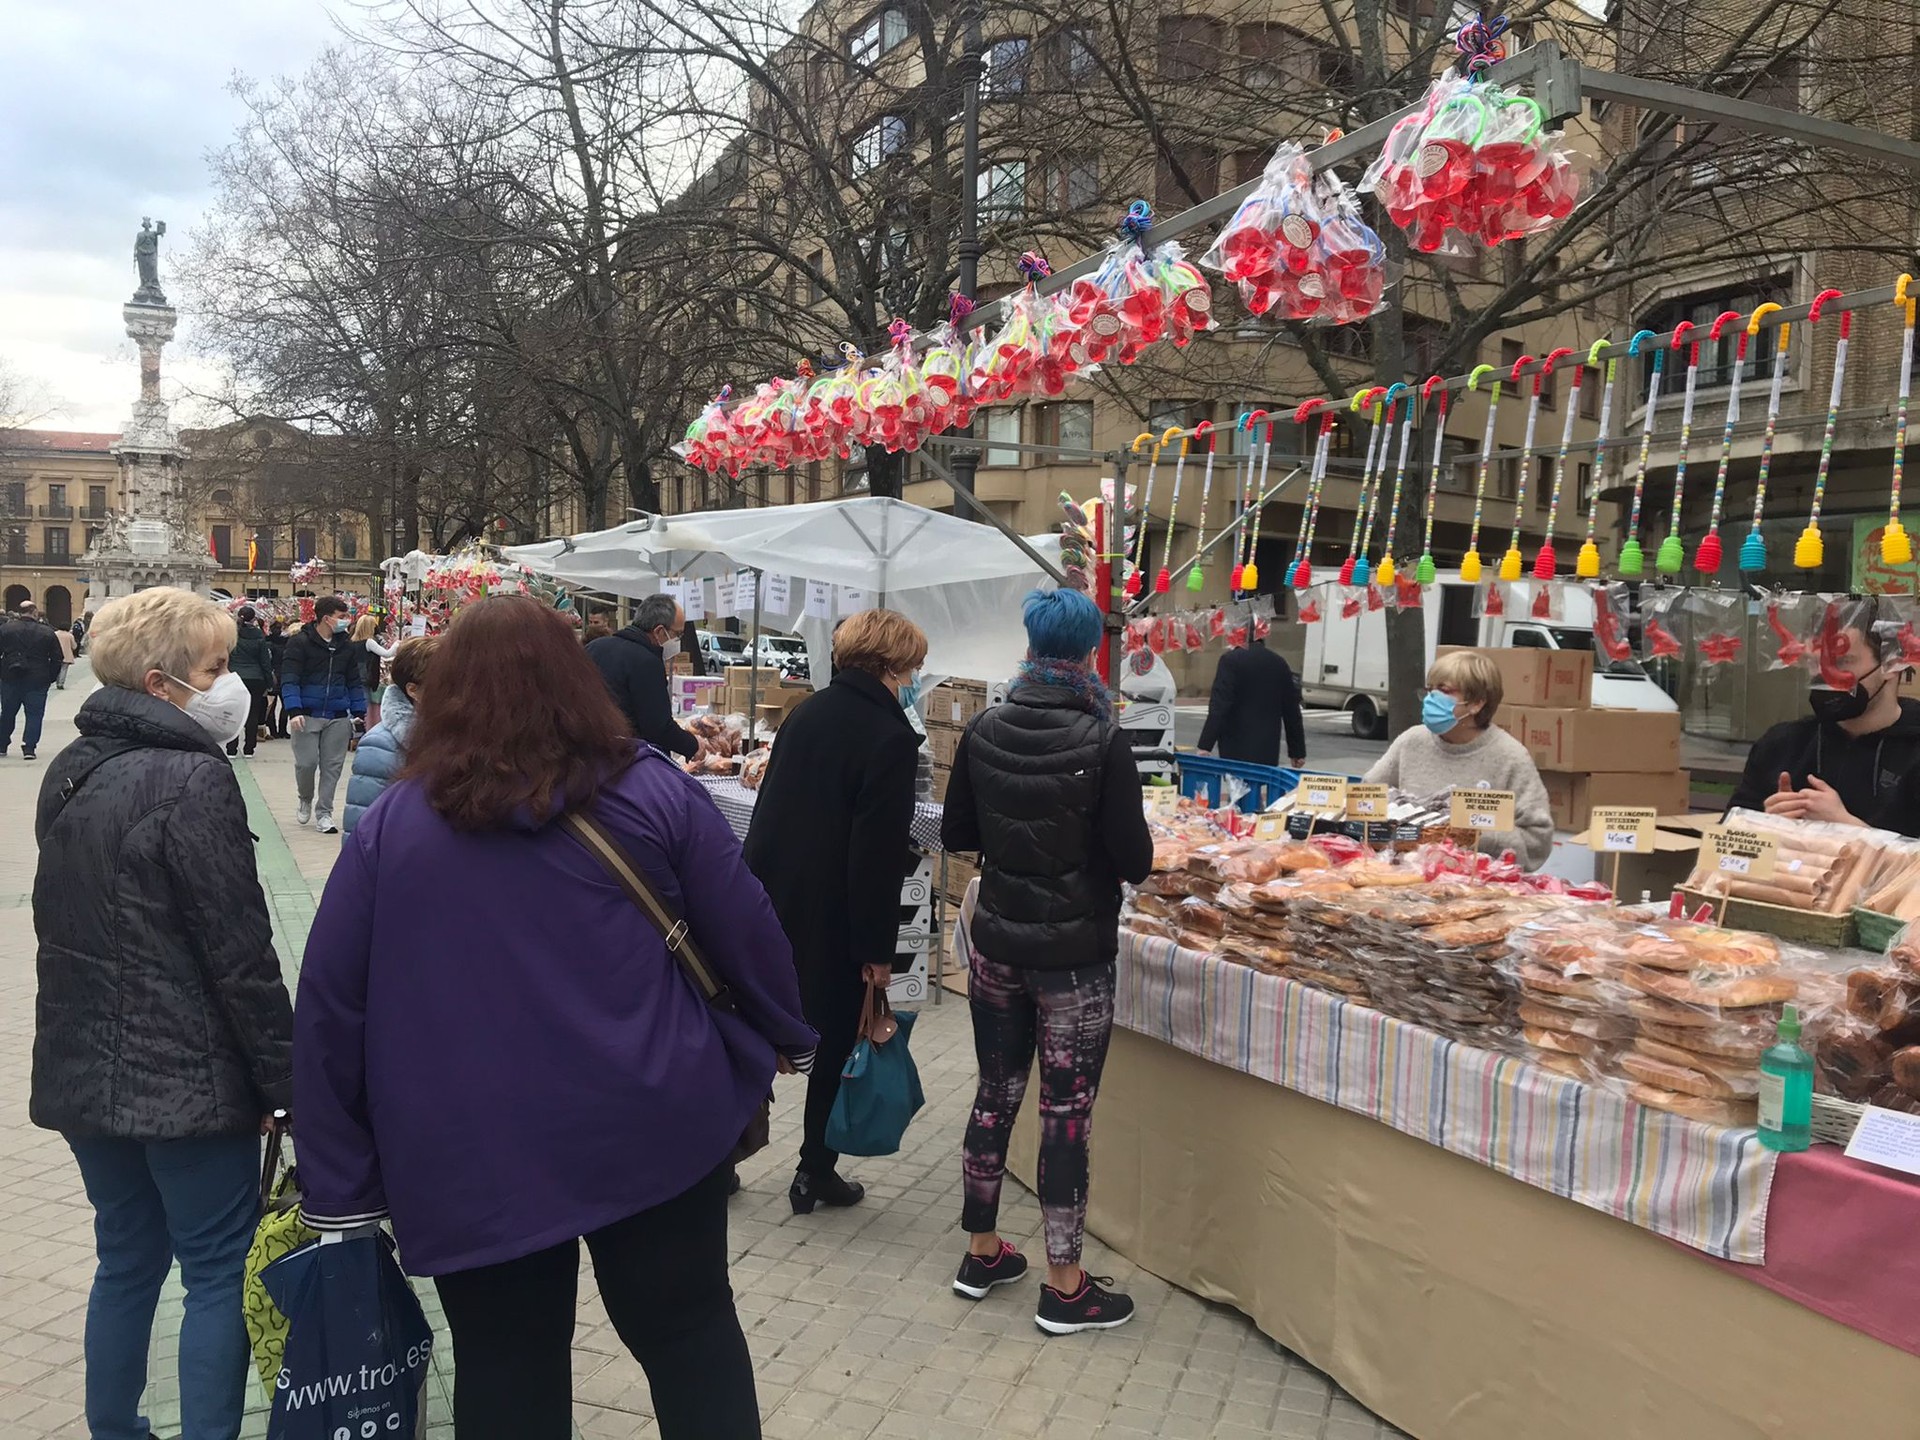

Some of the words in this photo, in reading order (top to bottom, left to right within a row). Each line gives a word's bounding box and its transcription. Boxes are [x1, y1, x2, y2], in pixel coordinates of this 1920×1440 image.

[1726, 829, 1757, 839] ROSCO
[1708, 832, 1773, 848] TRADICIONAL
[1716, 847, 1728, 855] DE
